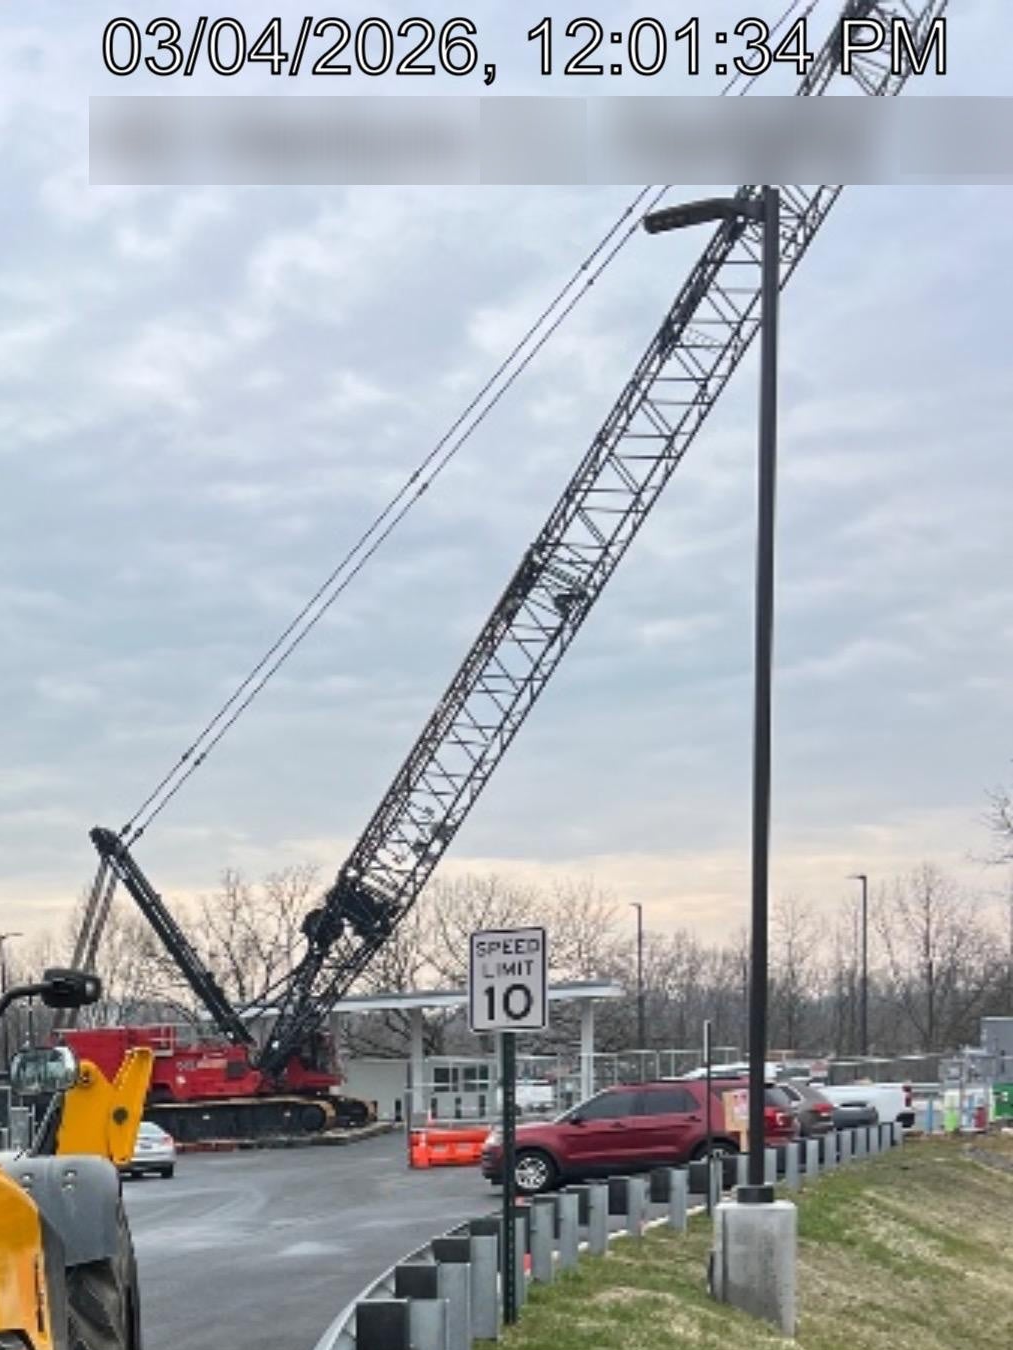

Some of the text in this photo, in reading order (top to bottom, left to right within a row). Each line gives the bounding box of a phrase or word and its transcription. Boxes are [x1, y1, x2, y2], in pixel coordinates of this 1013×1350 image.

[476, 938, 540, 957] SPEED
[482, 959, 534, 978] LIMIT
[484, 983, 534, 1020] 10
